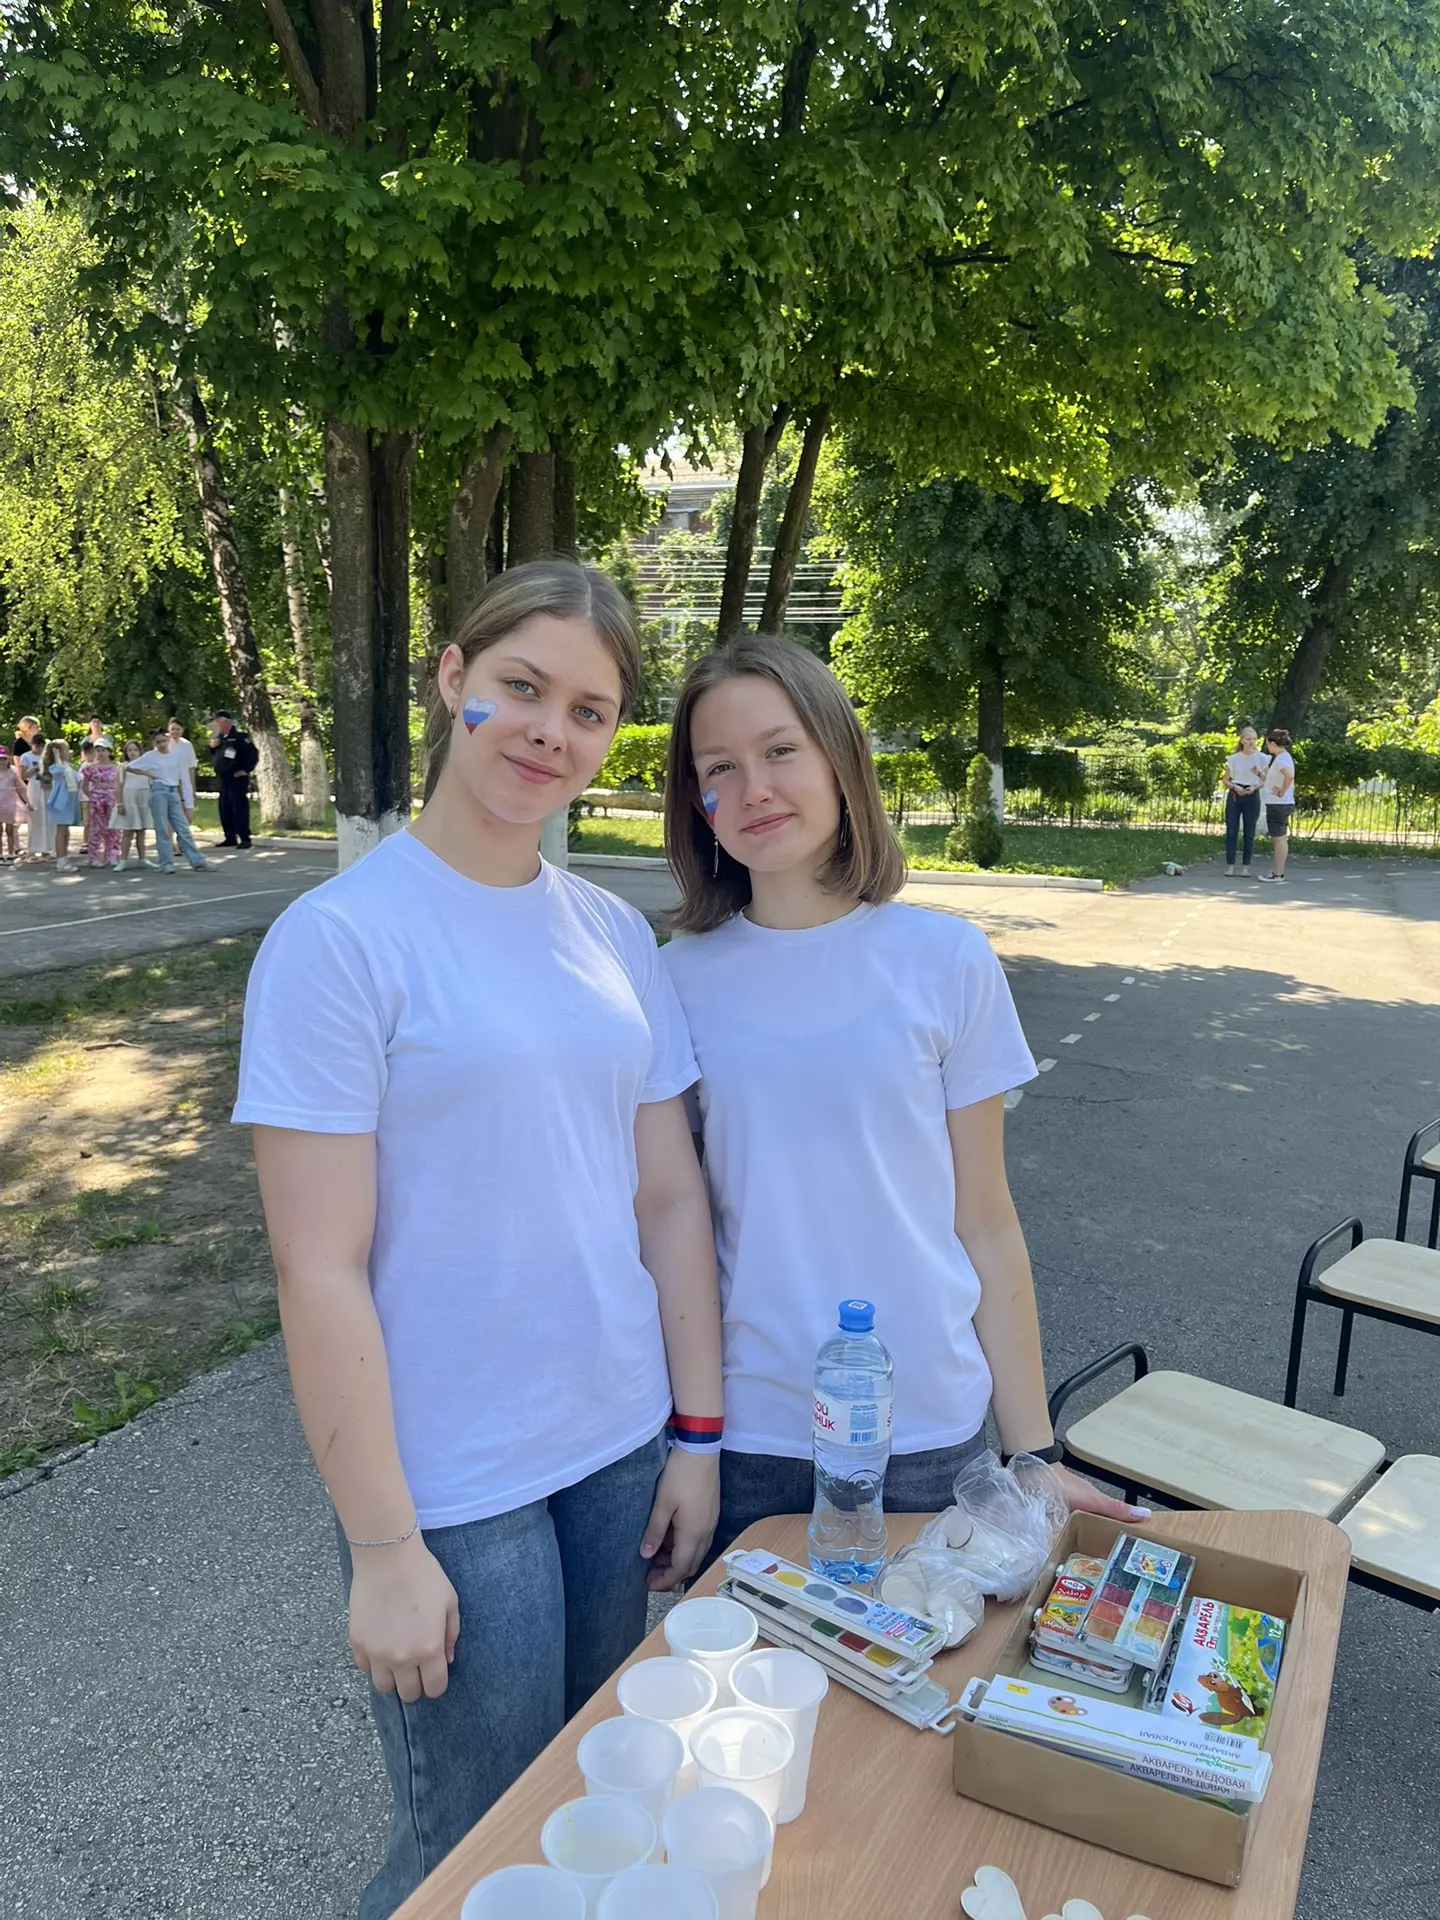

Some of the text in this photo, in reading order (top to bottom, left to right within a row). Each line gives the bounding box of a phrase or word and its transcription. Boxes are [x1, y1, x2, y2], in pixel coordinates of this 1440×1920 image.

[1193, 1601, 1215, 1647] АКВАРЕЛЬ
[1268, 1627, 1282, 1639] 12
[1139, 1730, 1241, 1759] АКВАРЕЛЬ МЕДОВАЯ
[1129, 1763, 1230, 1794] АКВАРЕЛЬ МЕДОВАЯ
[1142, 1755, 1245, 1790] АКВАРЕЛЬ МЕДОВАЯ
